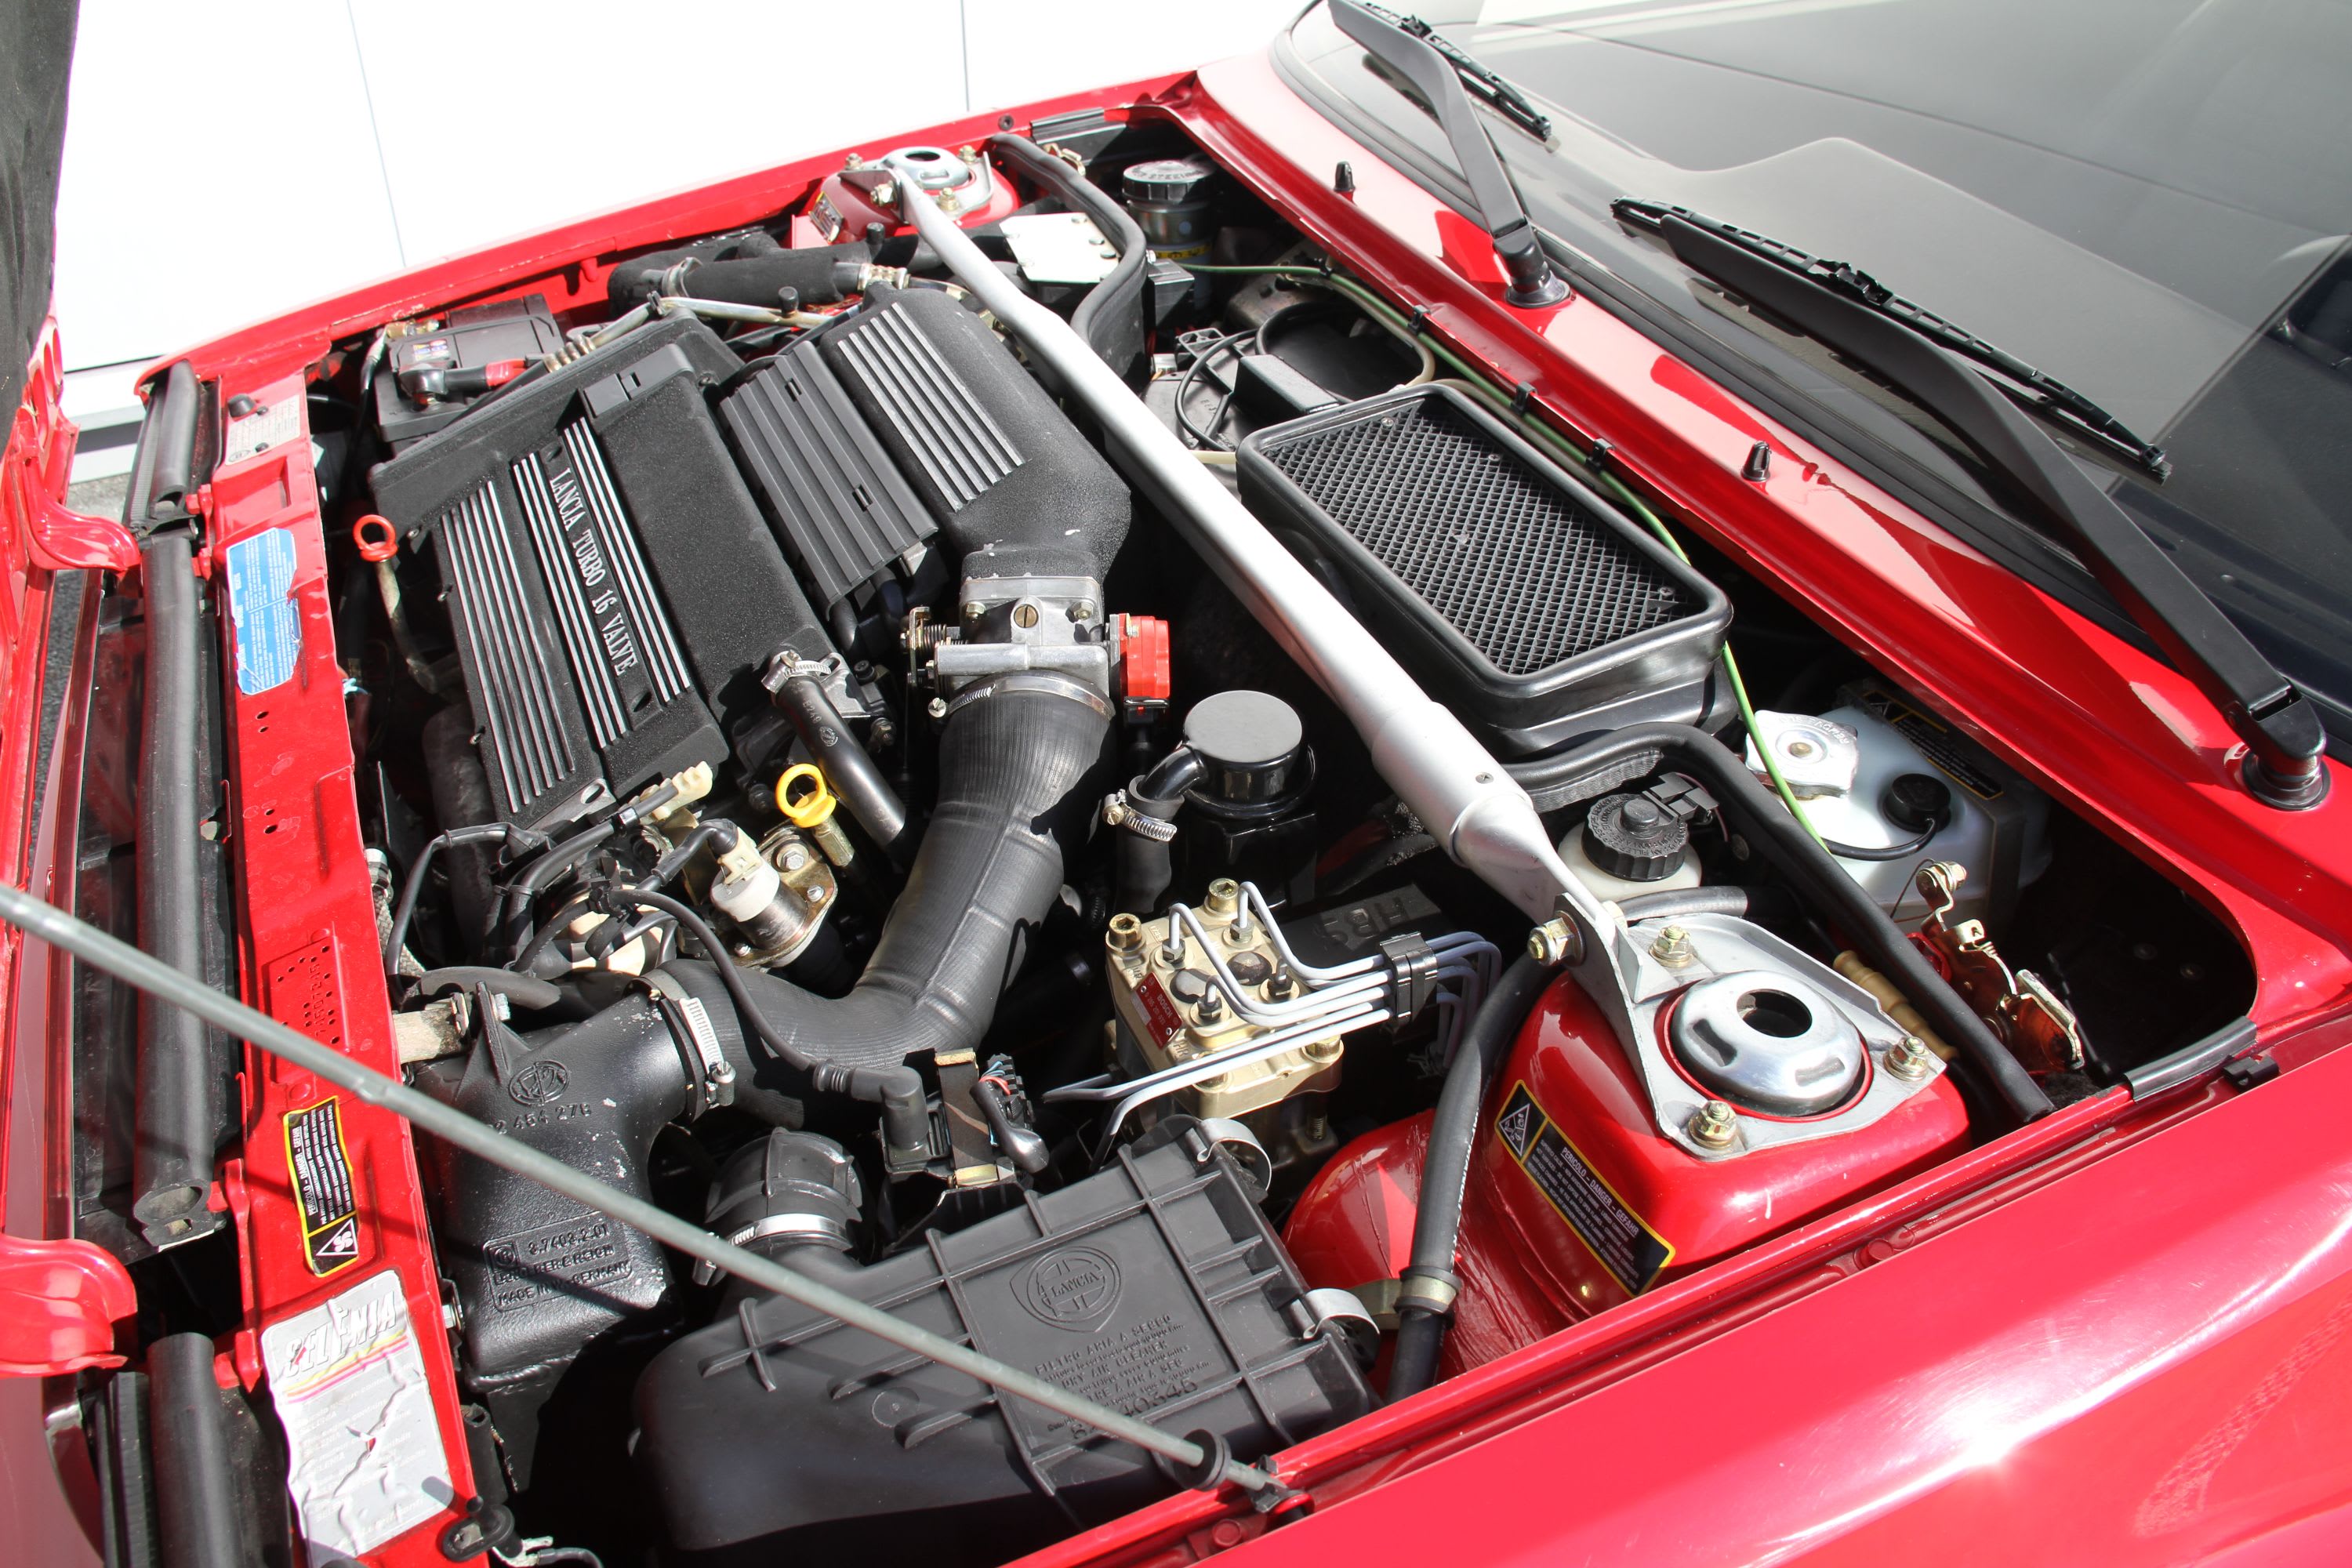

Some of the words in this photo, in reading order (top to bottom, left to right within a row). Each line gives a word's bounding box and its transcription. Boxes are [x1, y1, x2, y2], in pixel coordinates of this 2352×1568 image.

[550, 467, 586, 532] LANCIA
[572, 528, 606, 586] TURBO
[592, 590, 616, 615] 16
[601, 612, 638, 676] VALVE
[1156, 993, 1173, 1018] BOSCH
[512, 1109, 549, 1130] 454
[296, 1152, 308, 1178] DANGER
[304, 1184, 317, 1215] PERICOLO
[1561, 1147, 1586, 1177] PERICOLO
[1590, 1179, 1612, 1206] DANGER
[1616, 1208, 1639, 1236] GEFAHR
[497, 1285, 535, 1305] MADE
[1051, 1272, 1099, 1298] LANCIA
[1034, 1350, 1081, 1375] FILTRO
[1084, 1335, 1115, 1355] ARIA
[1118, 1330, 1129, 1341] A
[1061, 1372, 1087, 1388] DRY
[1090, 1362, 1110, 1377] AIR
[1115, 1338, 1168, 1367] CLEANER
[1125, 1373, 1145, 1388] AIR
